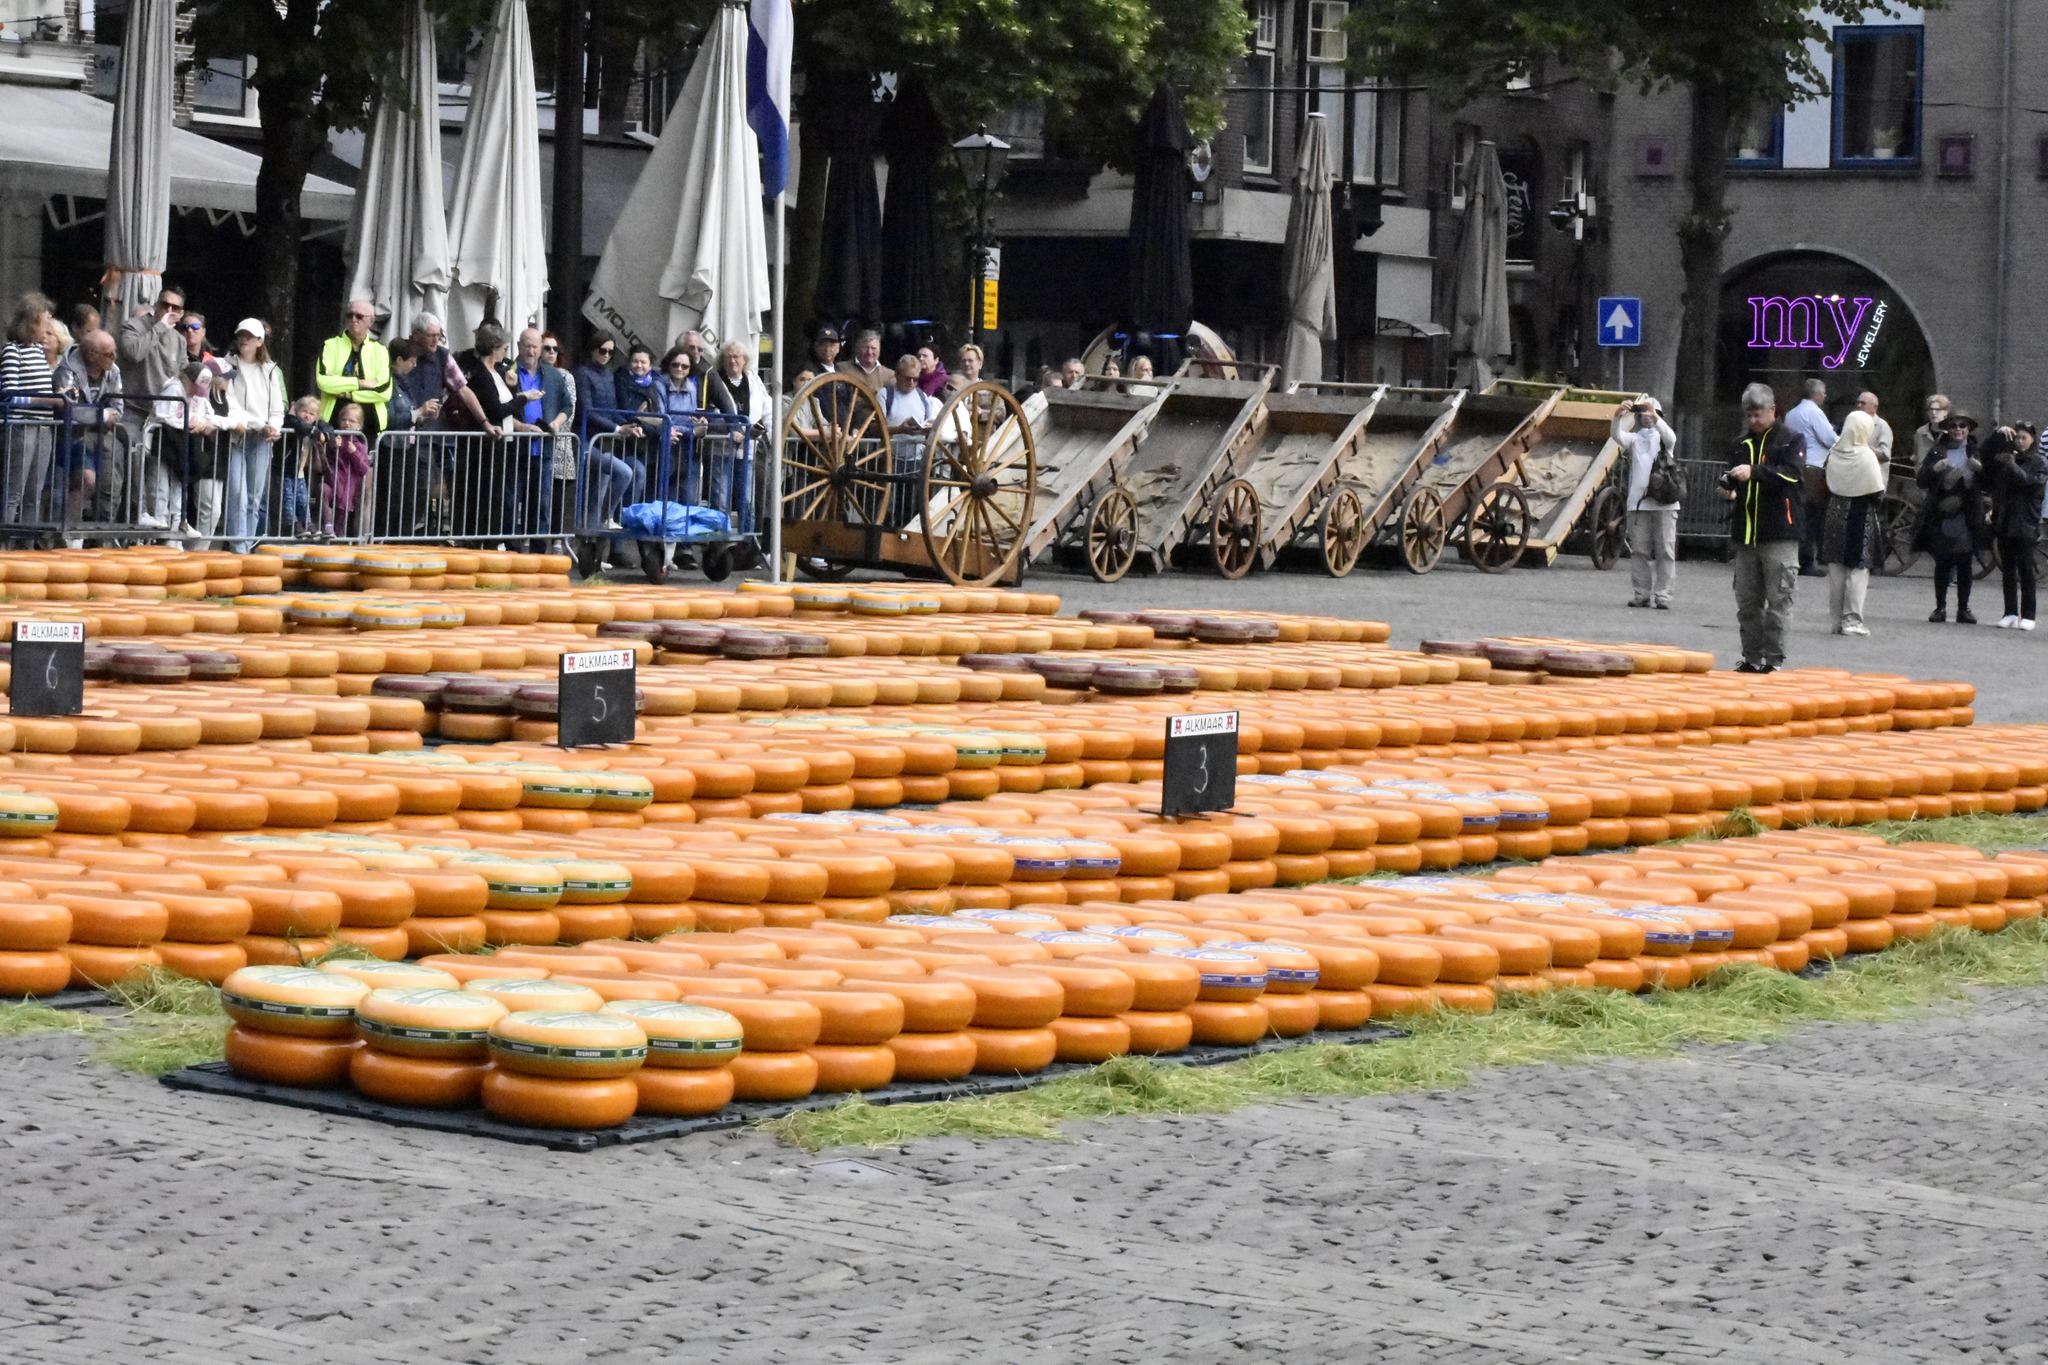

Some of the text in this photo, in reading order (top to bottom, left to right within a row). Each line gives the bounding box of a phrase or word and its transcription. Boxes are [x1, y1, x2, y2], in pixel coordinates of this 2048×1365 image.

[1747, 296, 1873, 369] my
[1856, 299, 1889, 368] JEWELLERY
[31, 625, 70, 639] ALKMAAR
[46, 649, 59, 690] 6
[579, 653, 620, 669] ALKMAAR
[592, 685, 607, 722] 5
[1185, 716, 1224, 732] ALKMAAR
[1193, 745, 1209, 794] 3
